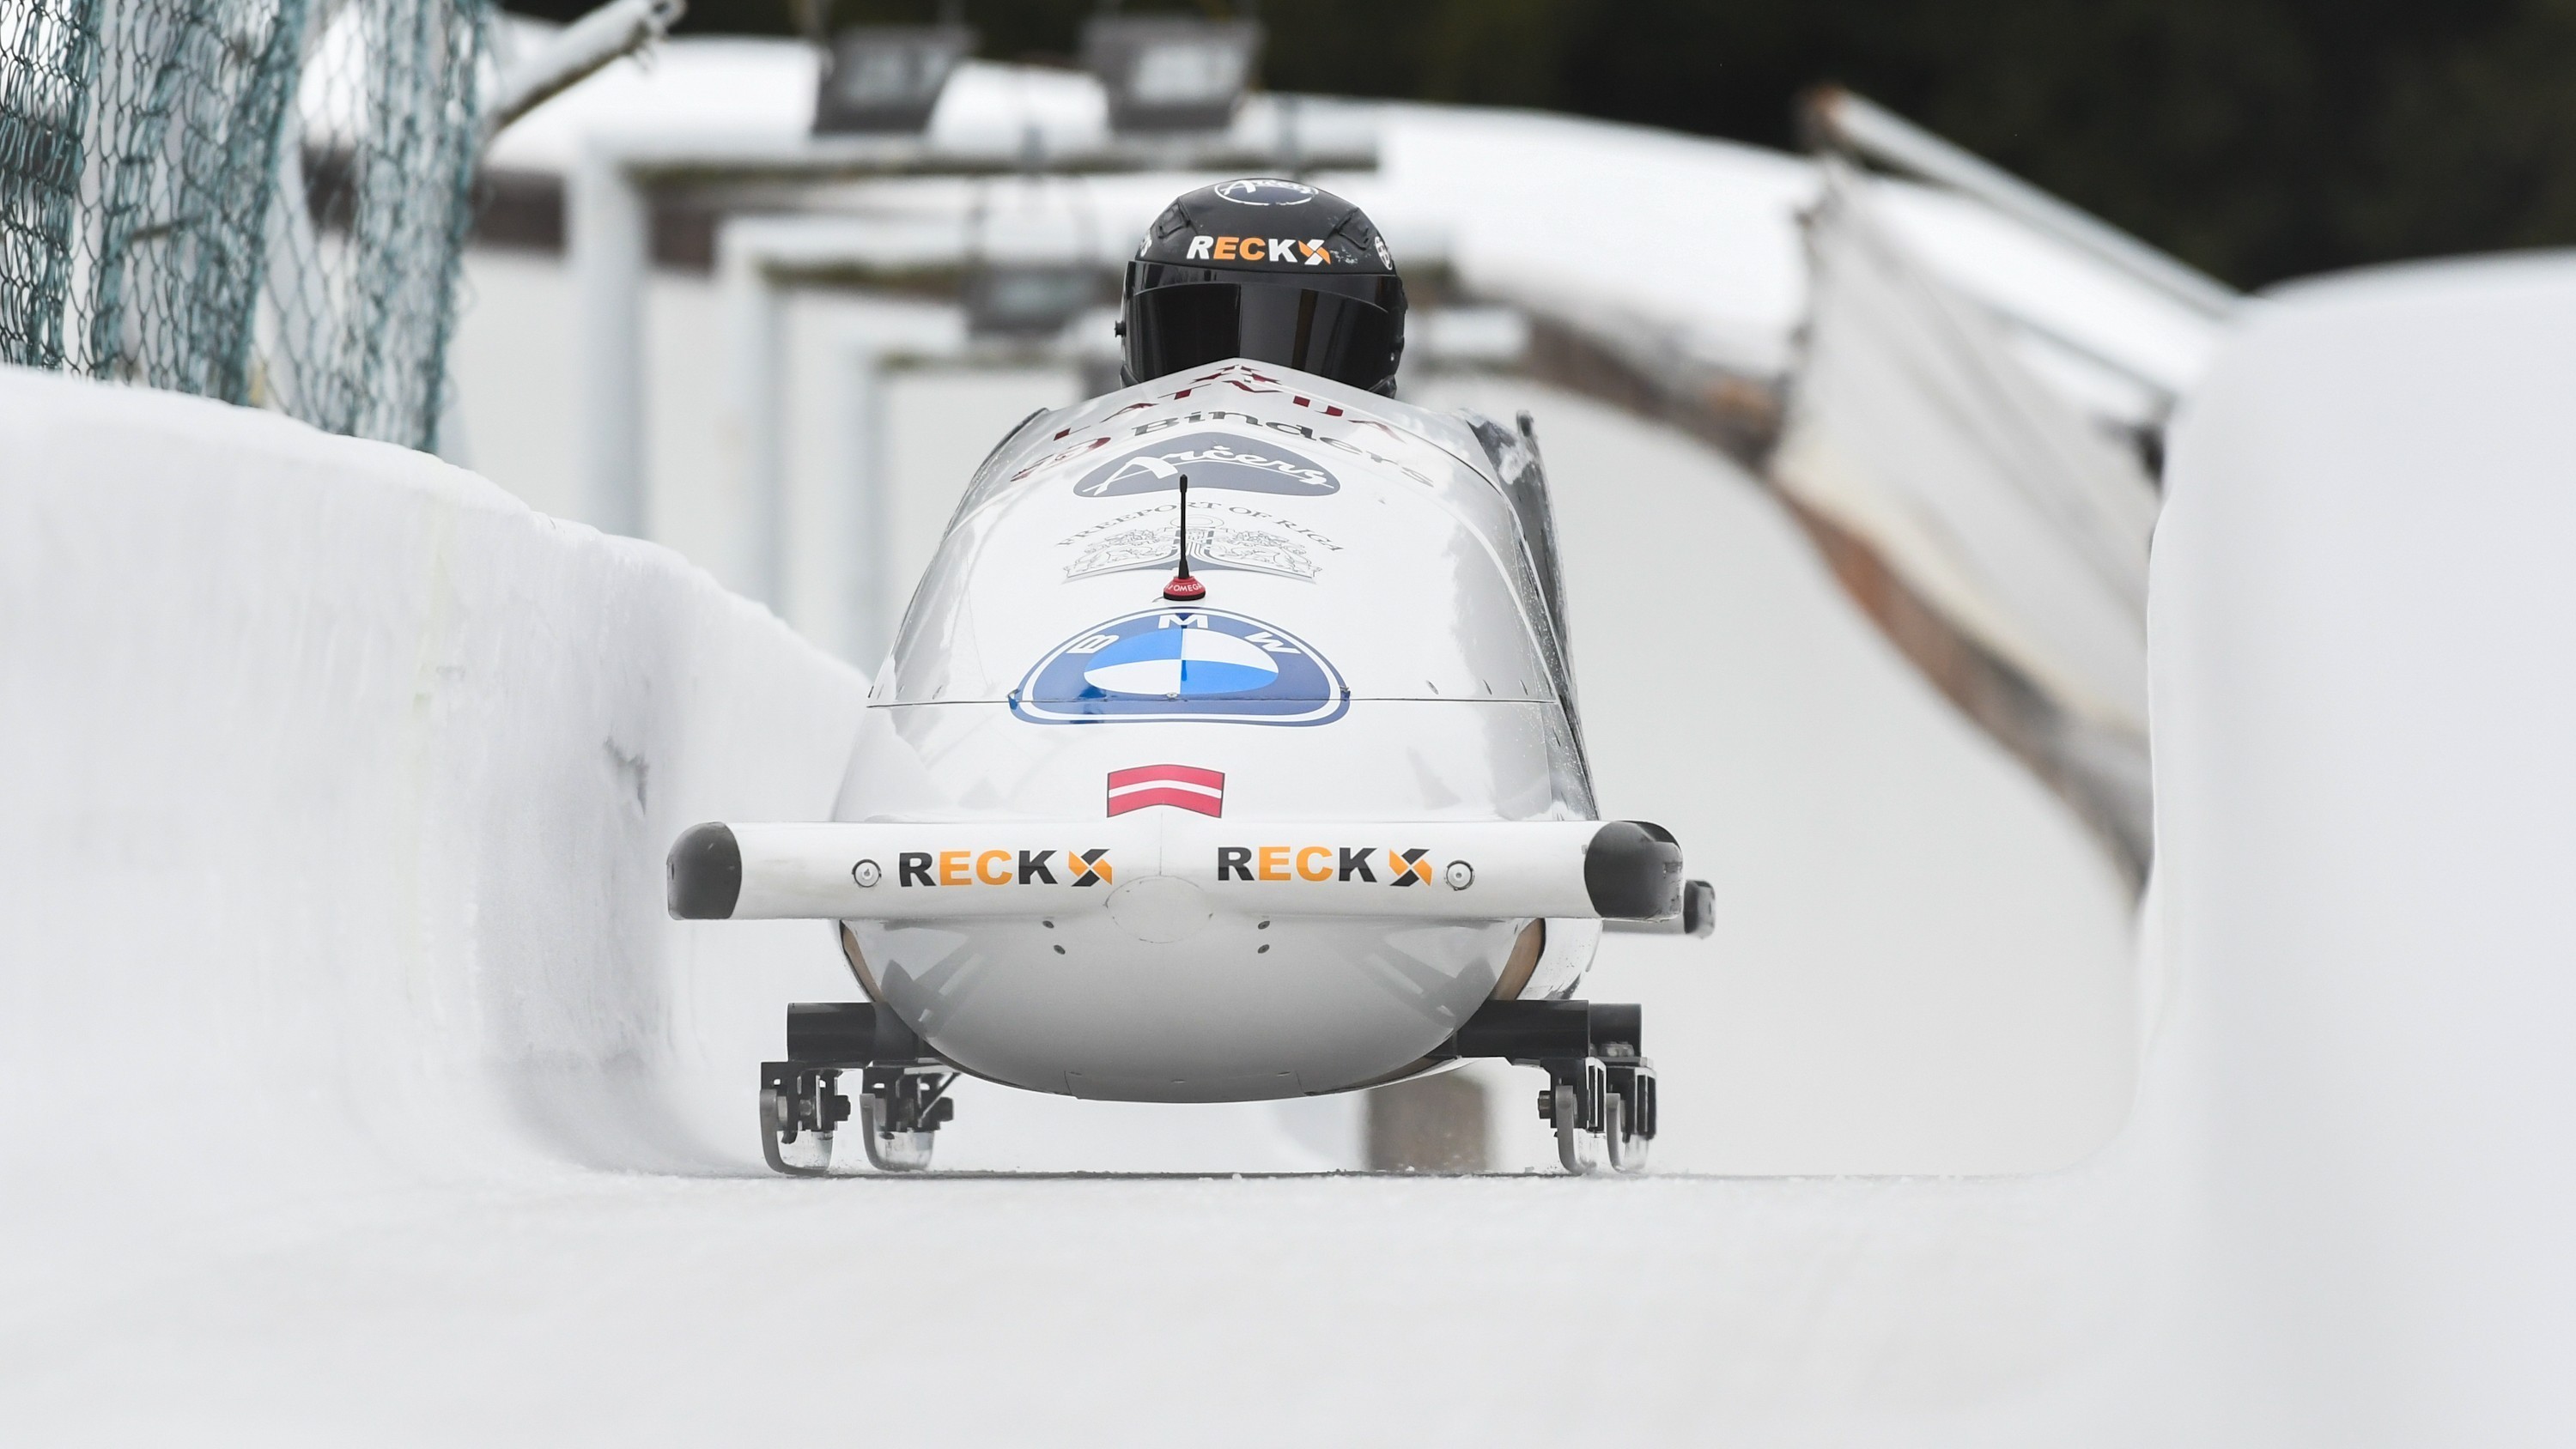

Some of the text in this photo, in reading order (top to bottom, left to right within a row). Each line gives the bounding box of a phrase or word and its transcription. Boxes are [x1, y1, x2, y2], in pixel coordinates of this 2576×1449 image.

[1131, 410, 1434, 488] Binders
[1054, 501, 1346, 552] FREEPORT OF RIGA
[1066, 613, 1302, 655] BMW
